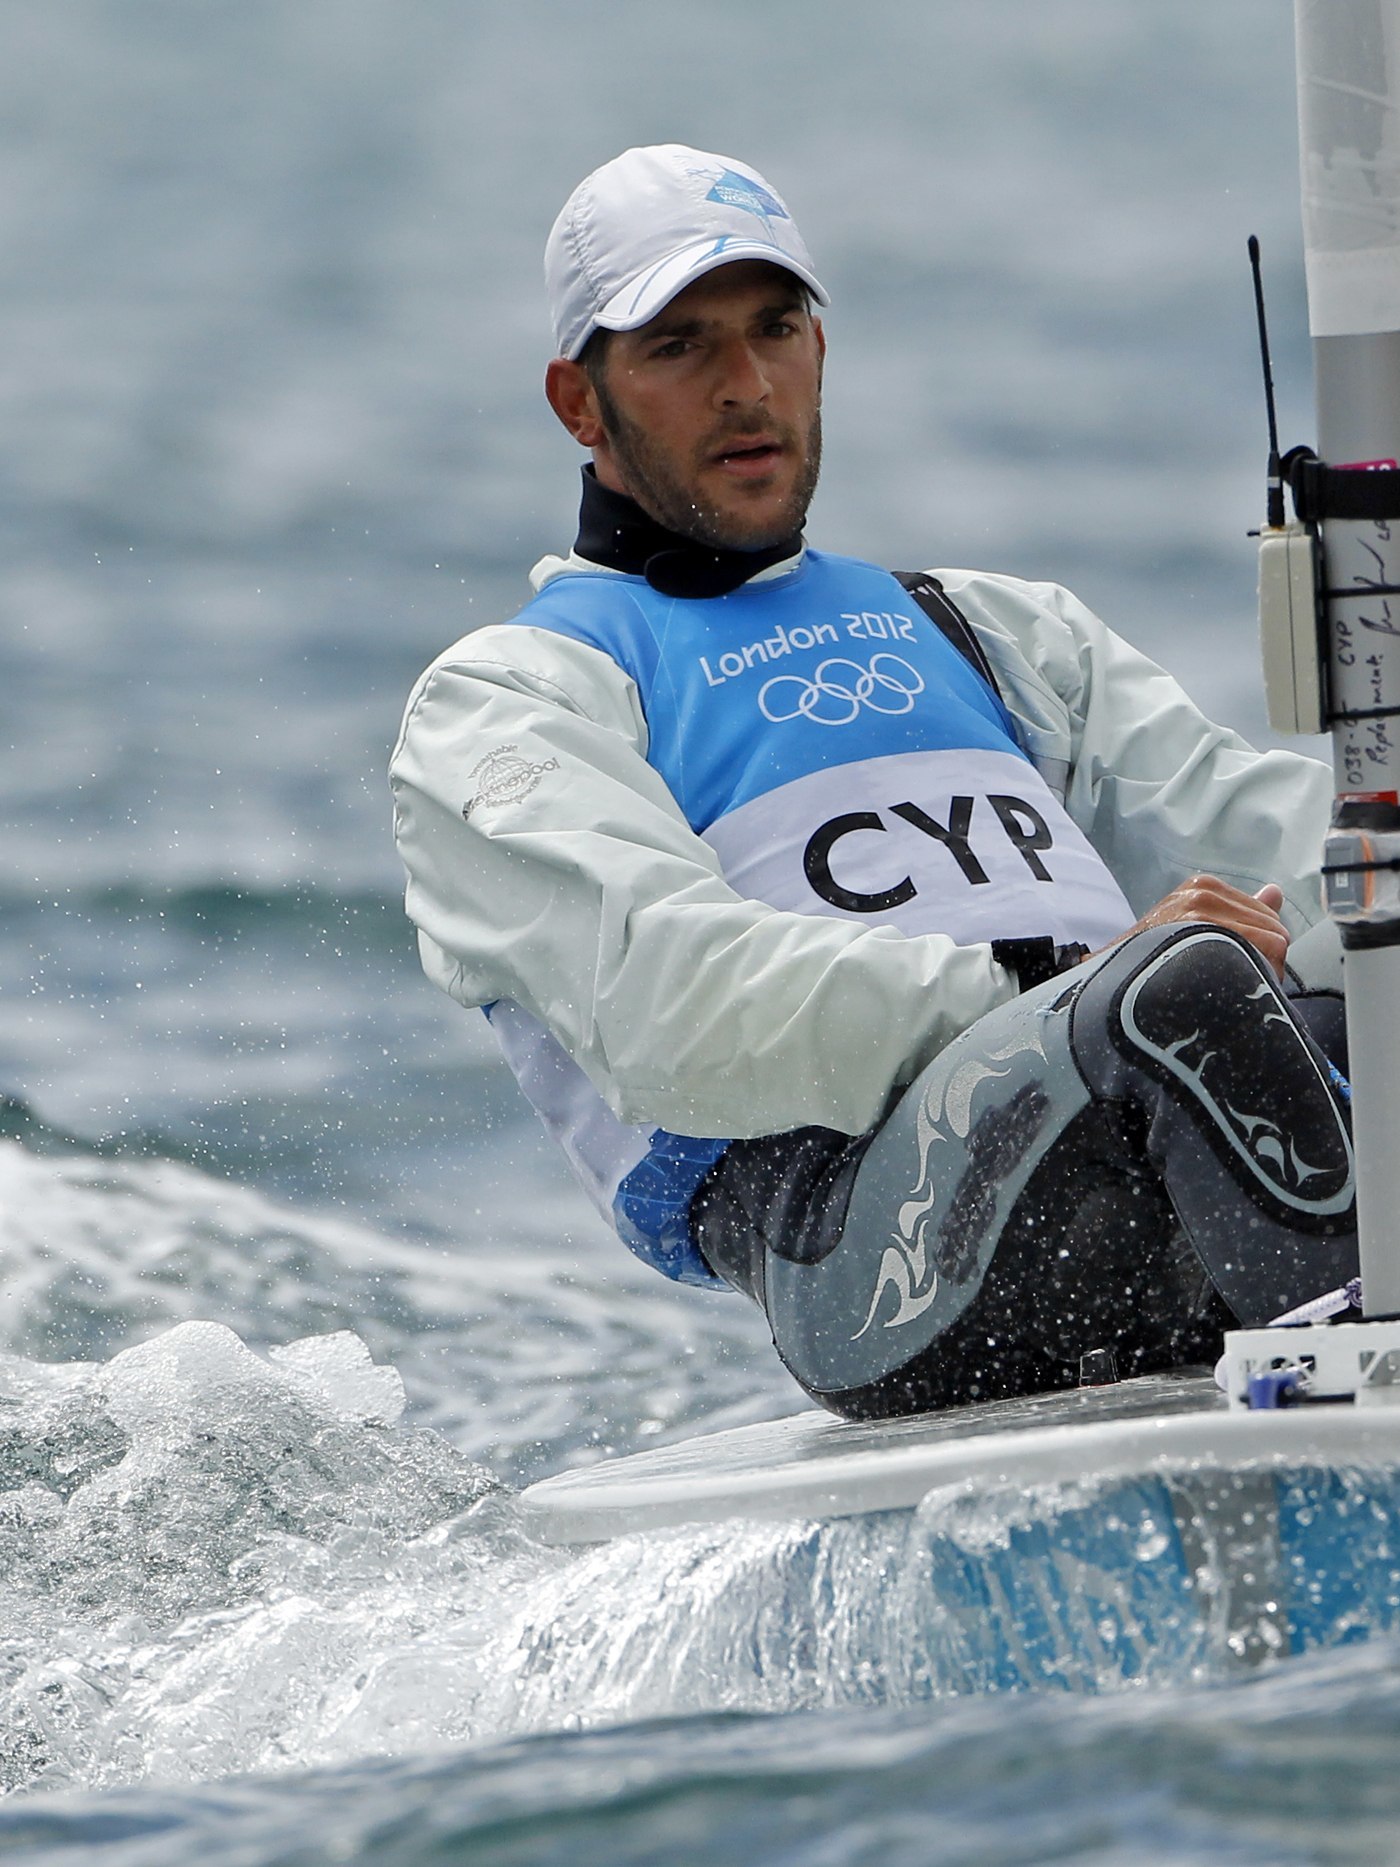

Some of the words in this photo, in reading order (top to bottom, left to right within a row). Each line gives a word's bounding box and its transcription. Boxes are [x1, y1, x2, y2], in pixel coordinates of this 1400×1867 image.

[699, 624, 840, 687] London
[840, 611, 918, 643] 2012
[1336, 620, 1356, 666] CYP
[803, 795, 1053, 913] CYP
